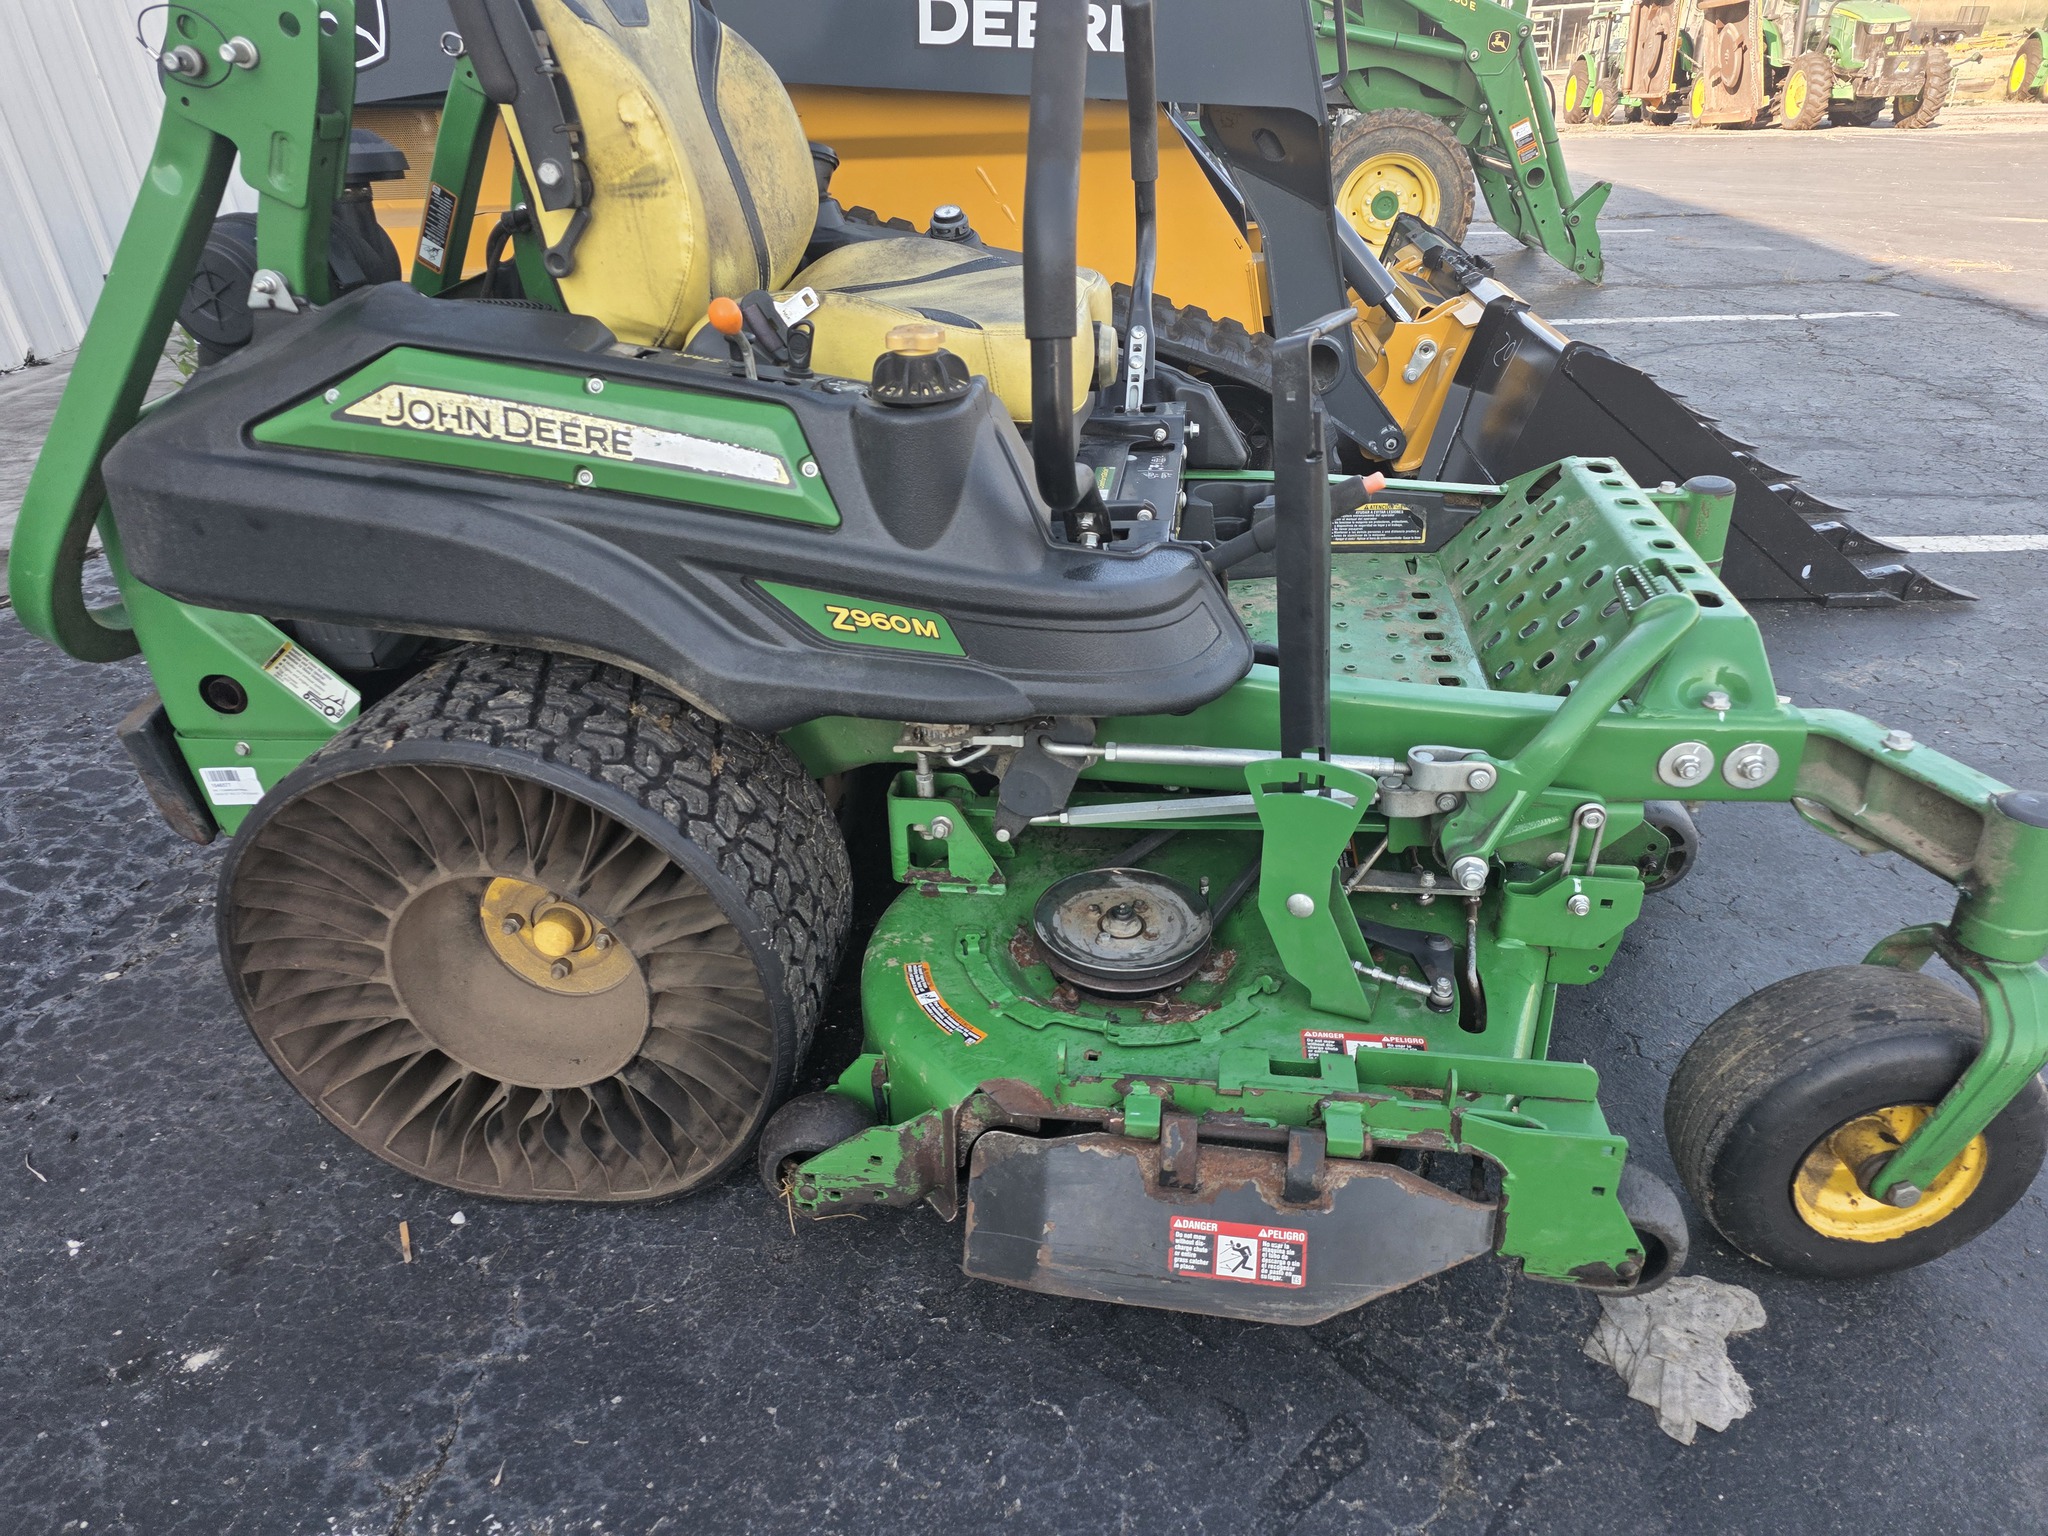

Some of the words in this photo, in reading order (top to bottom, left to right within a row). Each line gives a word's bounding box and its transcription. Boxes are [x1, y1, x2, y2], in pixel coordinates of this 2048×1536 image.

[385, 391, 491, 434] JOHN
[502, 406, 633, 457] DEERE
[824, 604, 941, 640] Z960M
[1183, 1220, 1218, 1232] DANGER
[1268, 1230, 1306, 1242] PELIGRO
